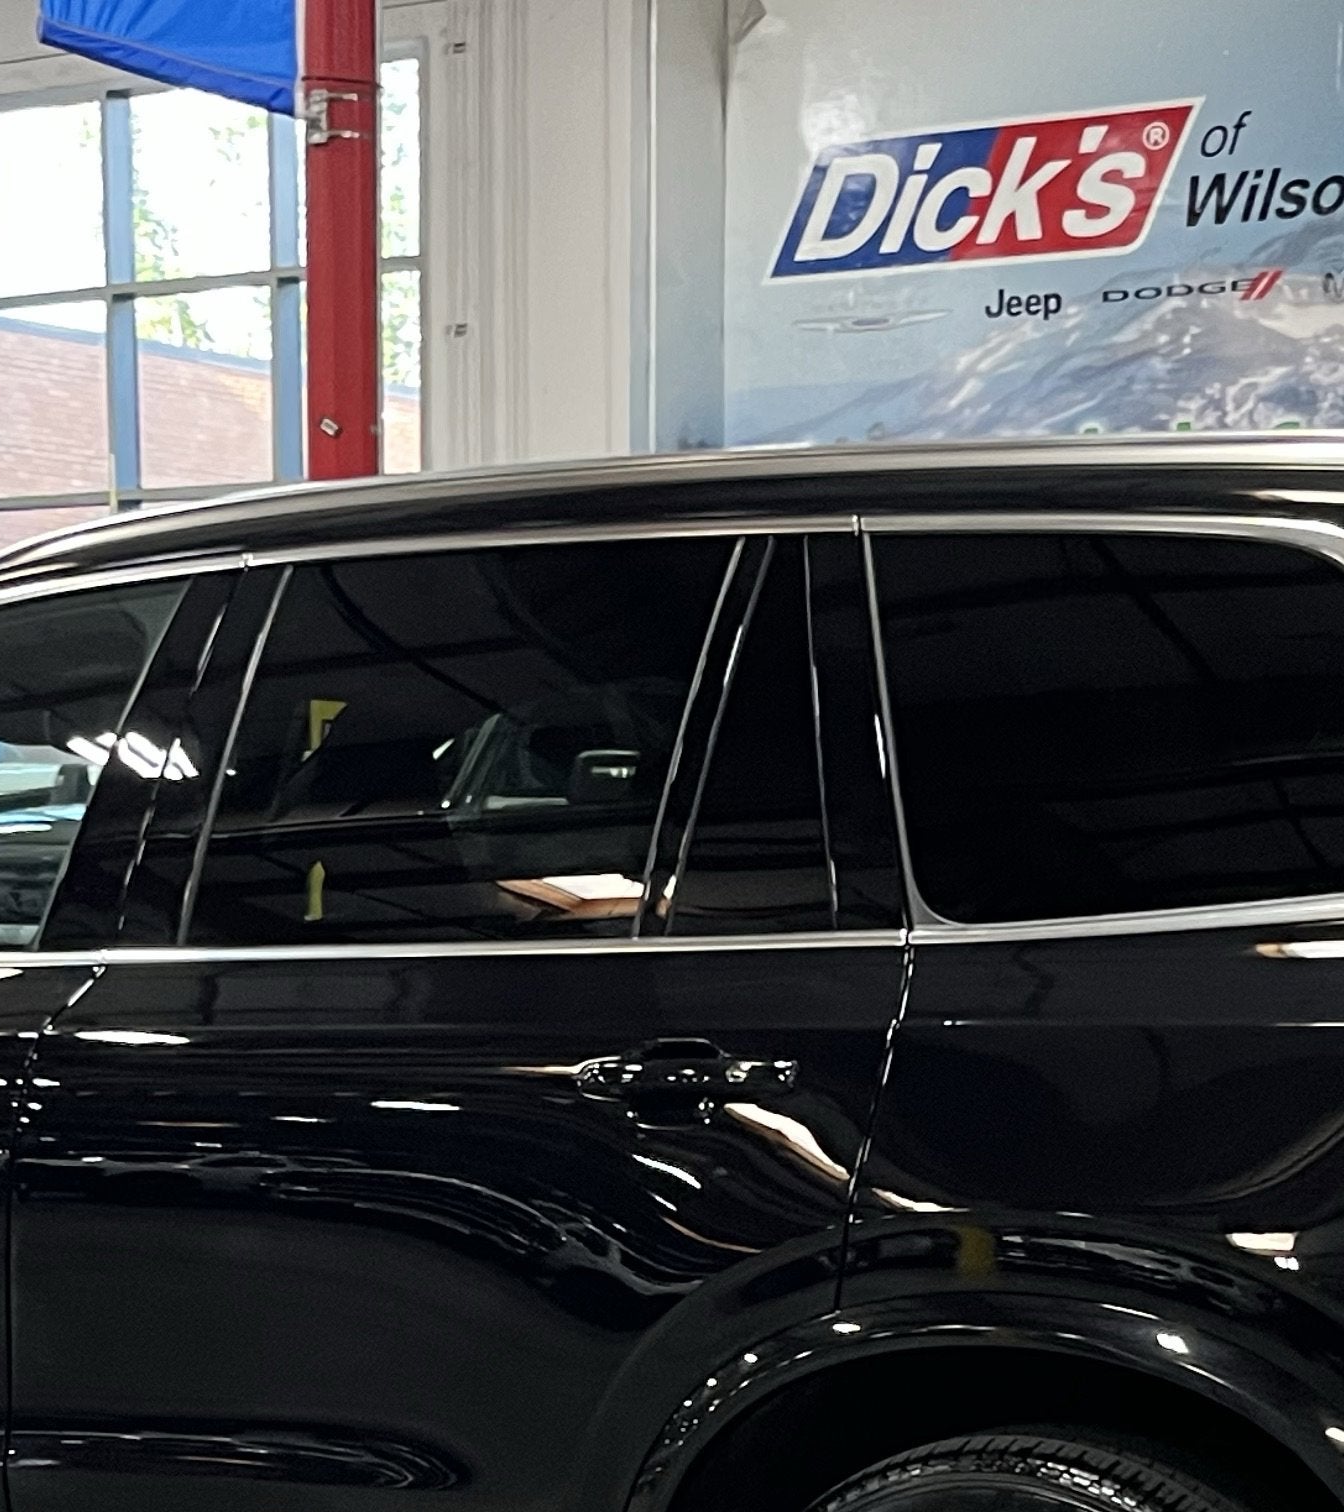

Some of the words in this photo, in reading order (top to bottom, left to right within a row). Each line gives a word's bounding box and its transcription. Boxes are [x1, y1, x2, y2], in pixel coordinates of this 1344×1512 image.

[1200, 111, 1252, 158] of
[985, 289, 1062, 320] Jeep
[1102, 278, 1254, 303] DODGE
